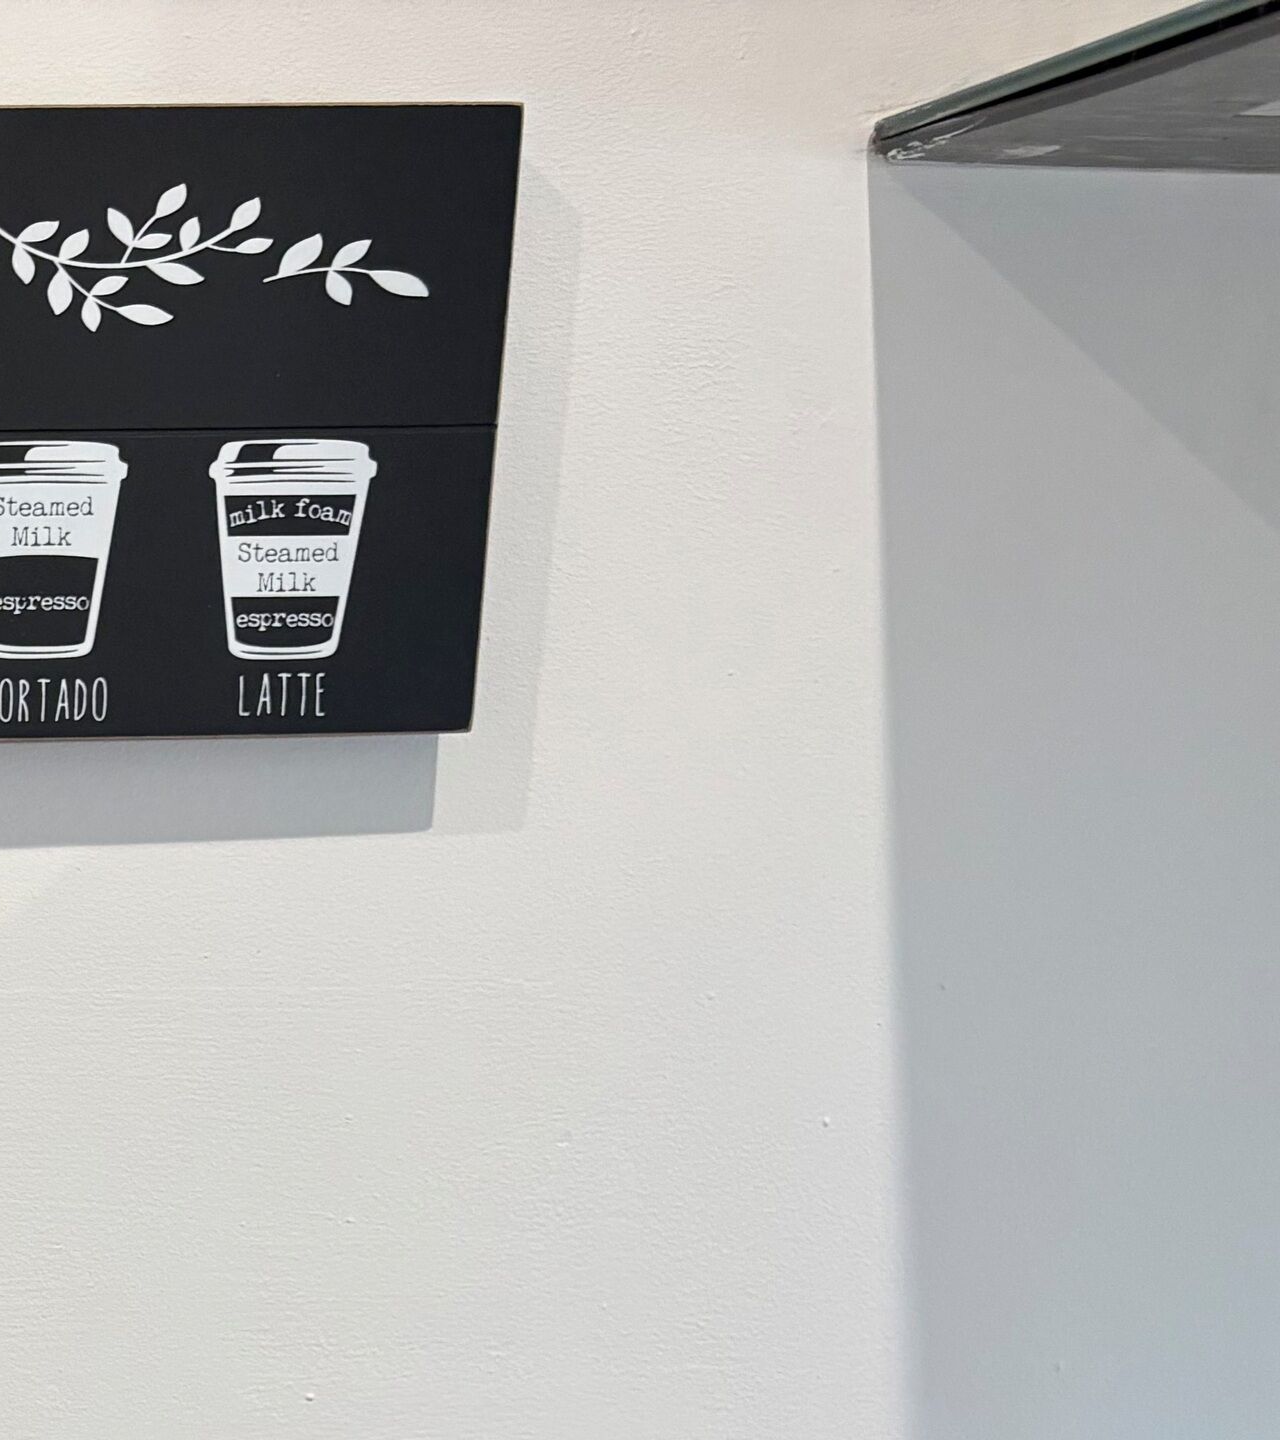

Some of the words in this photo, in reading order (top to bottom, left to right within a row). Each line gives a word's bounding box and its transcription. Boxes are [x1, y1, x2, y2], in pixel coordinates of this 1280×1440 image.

[229, 500, 285, 528] milk
[293, 499, 352, 528] foam
[11, 526, 72, 547] Milk
[237, 542, 340, 564] Steamed
[256, 572, 316, 593] Milk
[235, 611, 335, 632] espresso
[238, 672, 327, 718] LATTE
